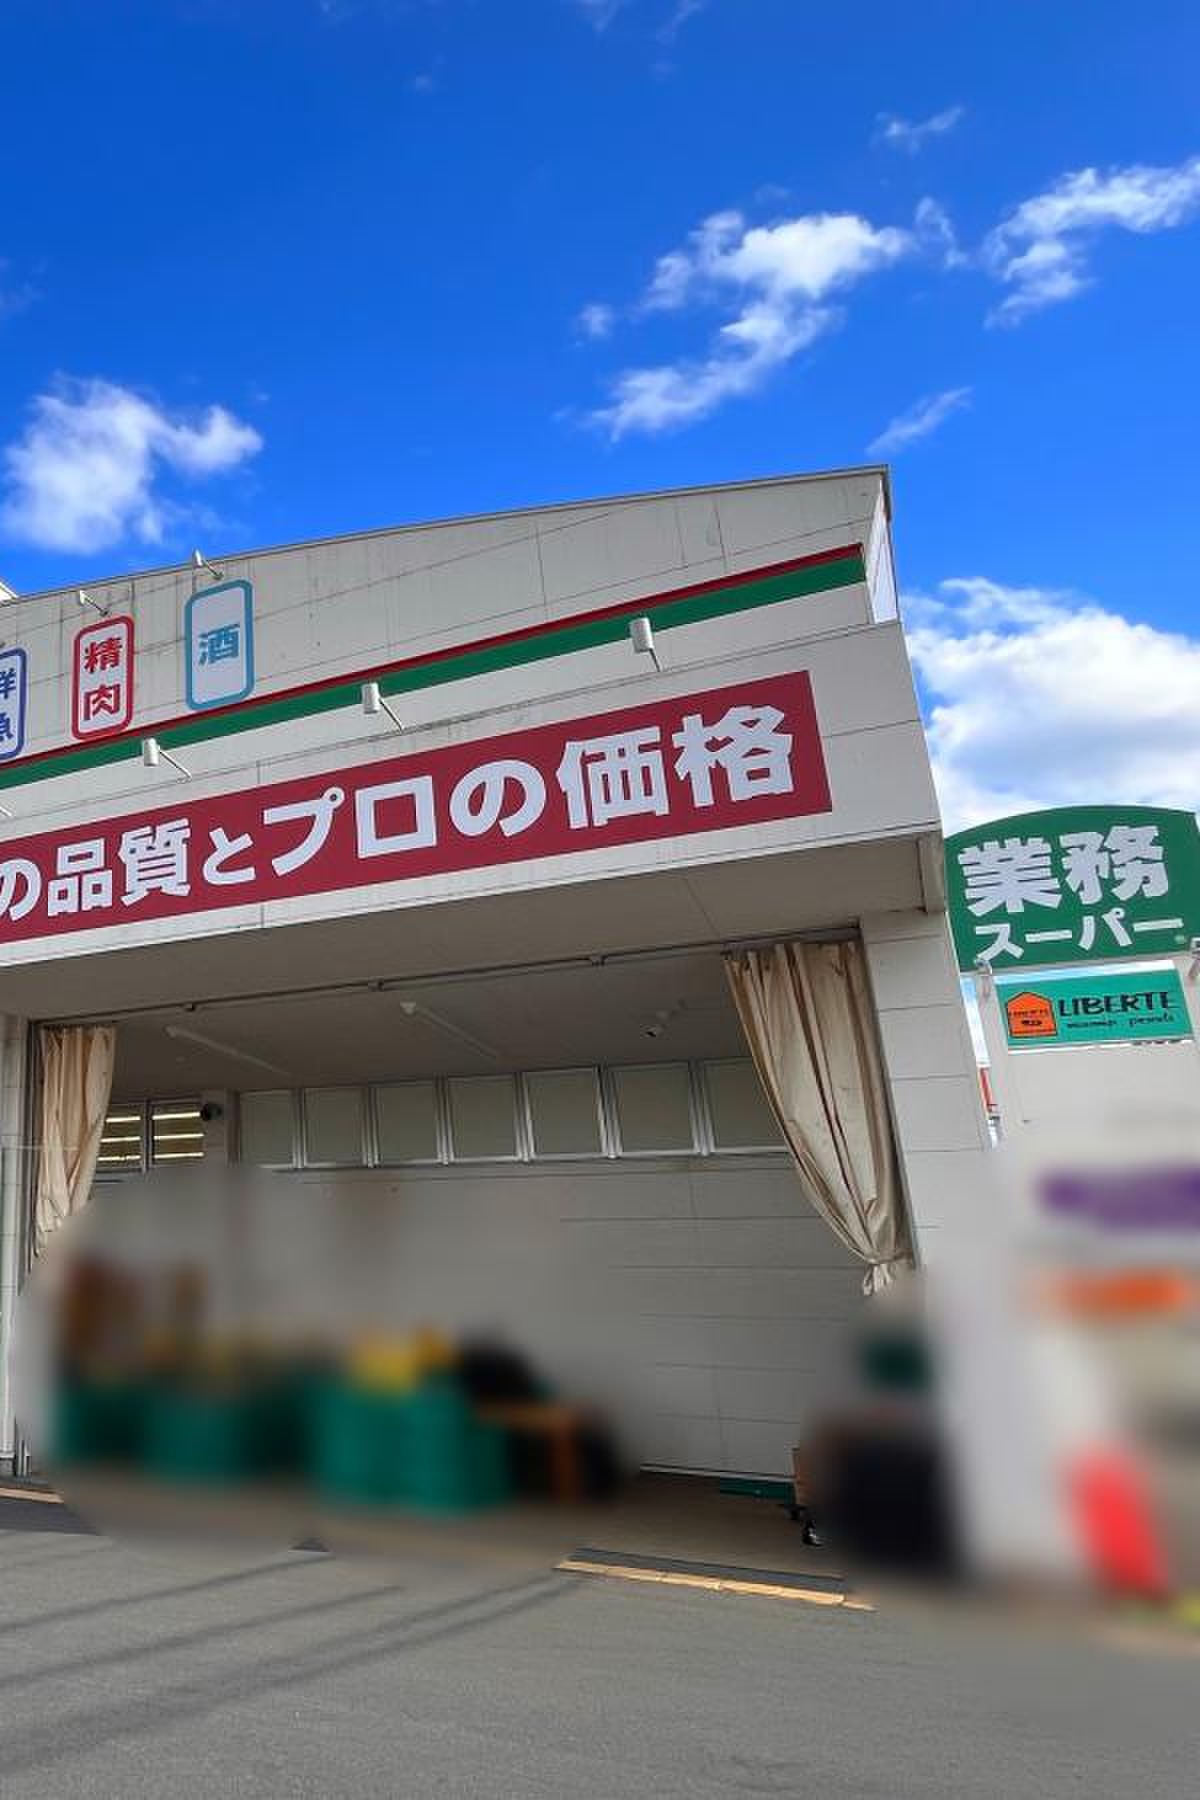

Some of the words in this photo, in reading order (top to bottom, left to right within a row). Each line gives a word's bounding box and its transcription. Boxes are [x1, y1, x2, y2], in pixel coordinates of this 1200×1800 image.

[82, 635, 123, 722] 精肉
[198, 622, 241, 665] 酒
[957, 825, 1169, 917] 業務
[973, 906, 1185, 963] スーパー
